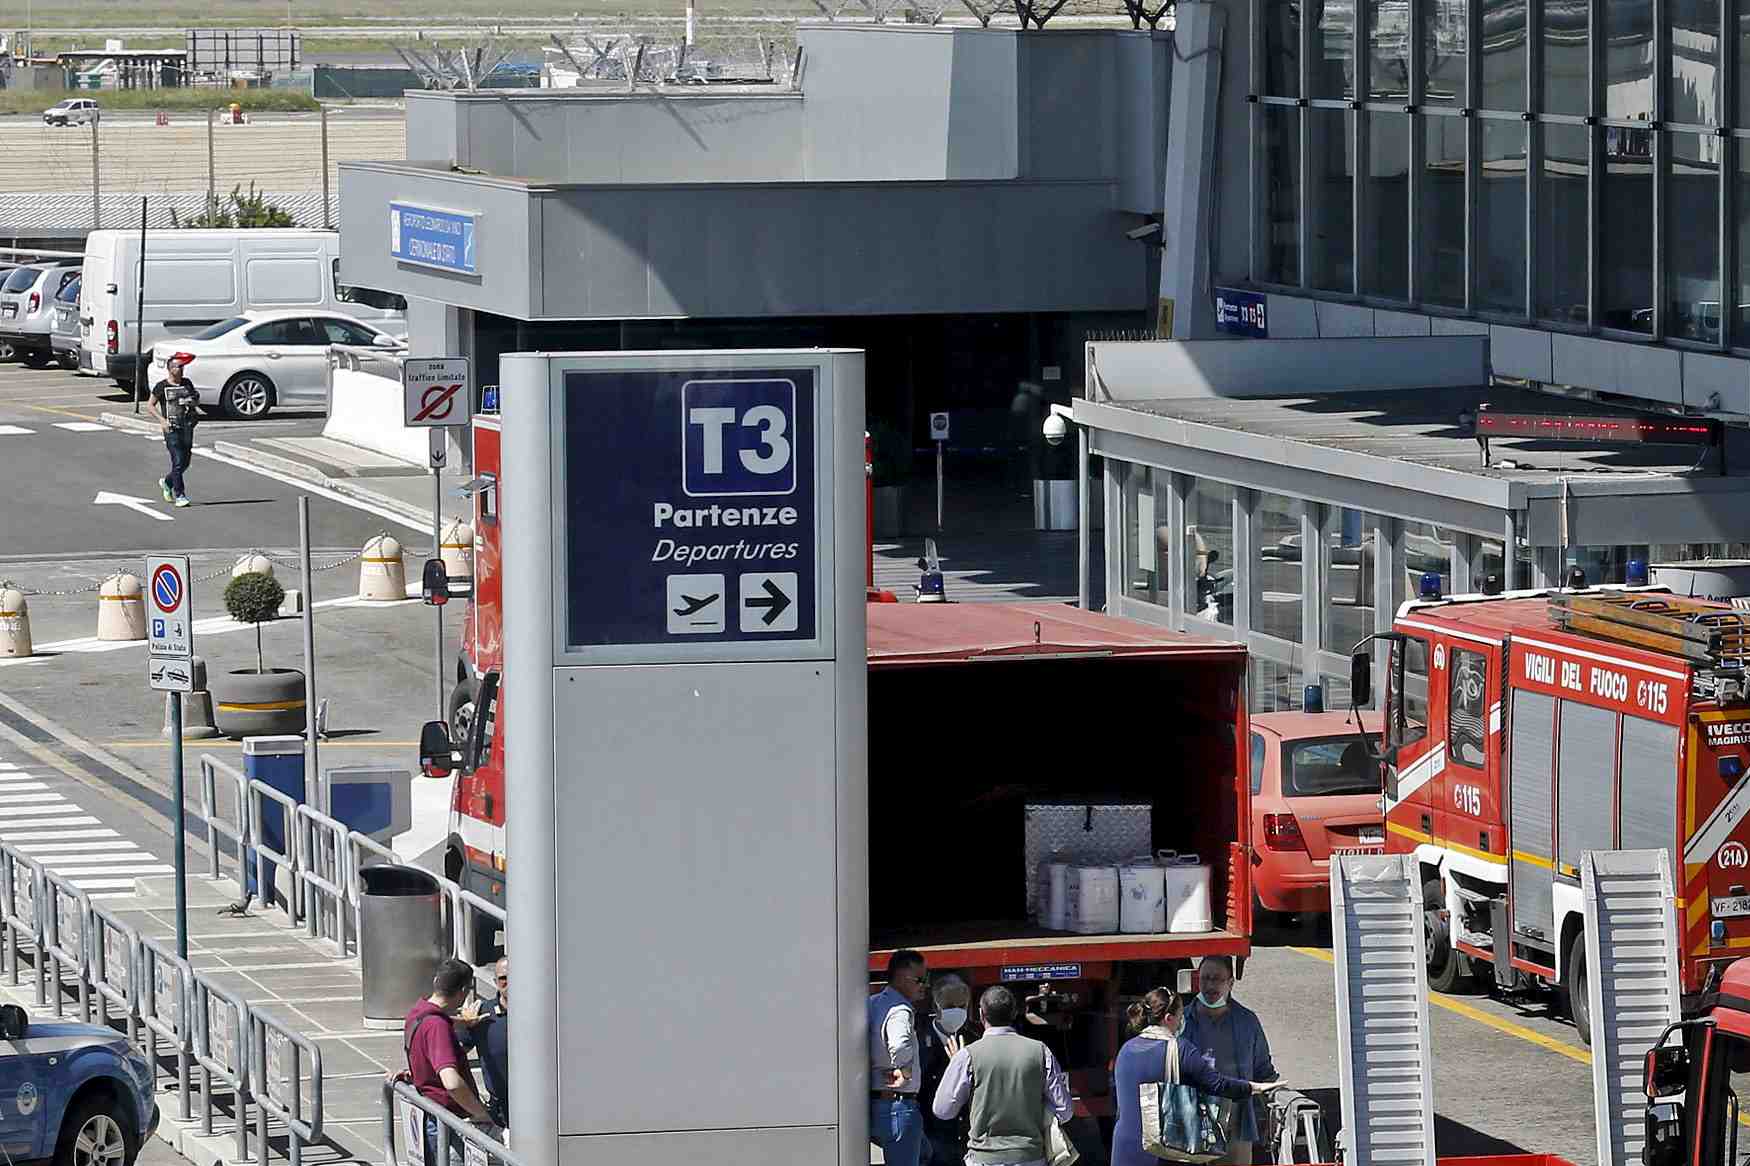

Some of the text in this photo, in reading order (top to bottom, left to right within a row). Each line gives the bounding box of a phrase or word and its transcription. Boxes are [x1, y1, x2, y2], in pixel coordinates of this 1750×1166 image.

[690, 405, 790, 474] T3
[653, 502, 798, 528] Partenze
[652, 539, 799, 567] Departures
[1524, 653, 1668, 714] VIGILI DEL FUOCO 115
[1462, 784, 1480, 816] 115
[1723, 848, 1744, 866] 21A
